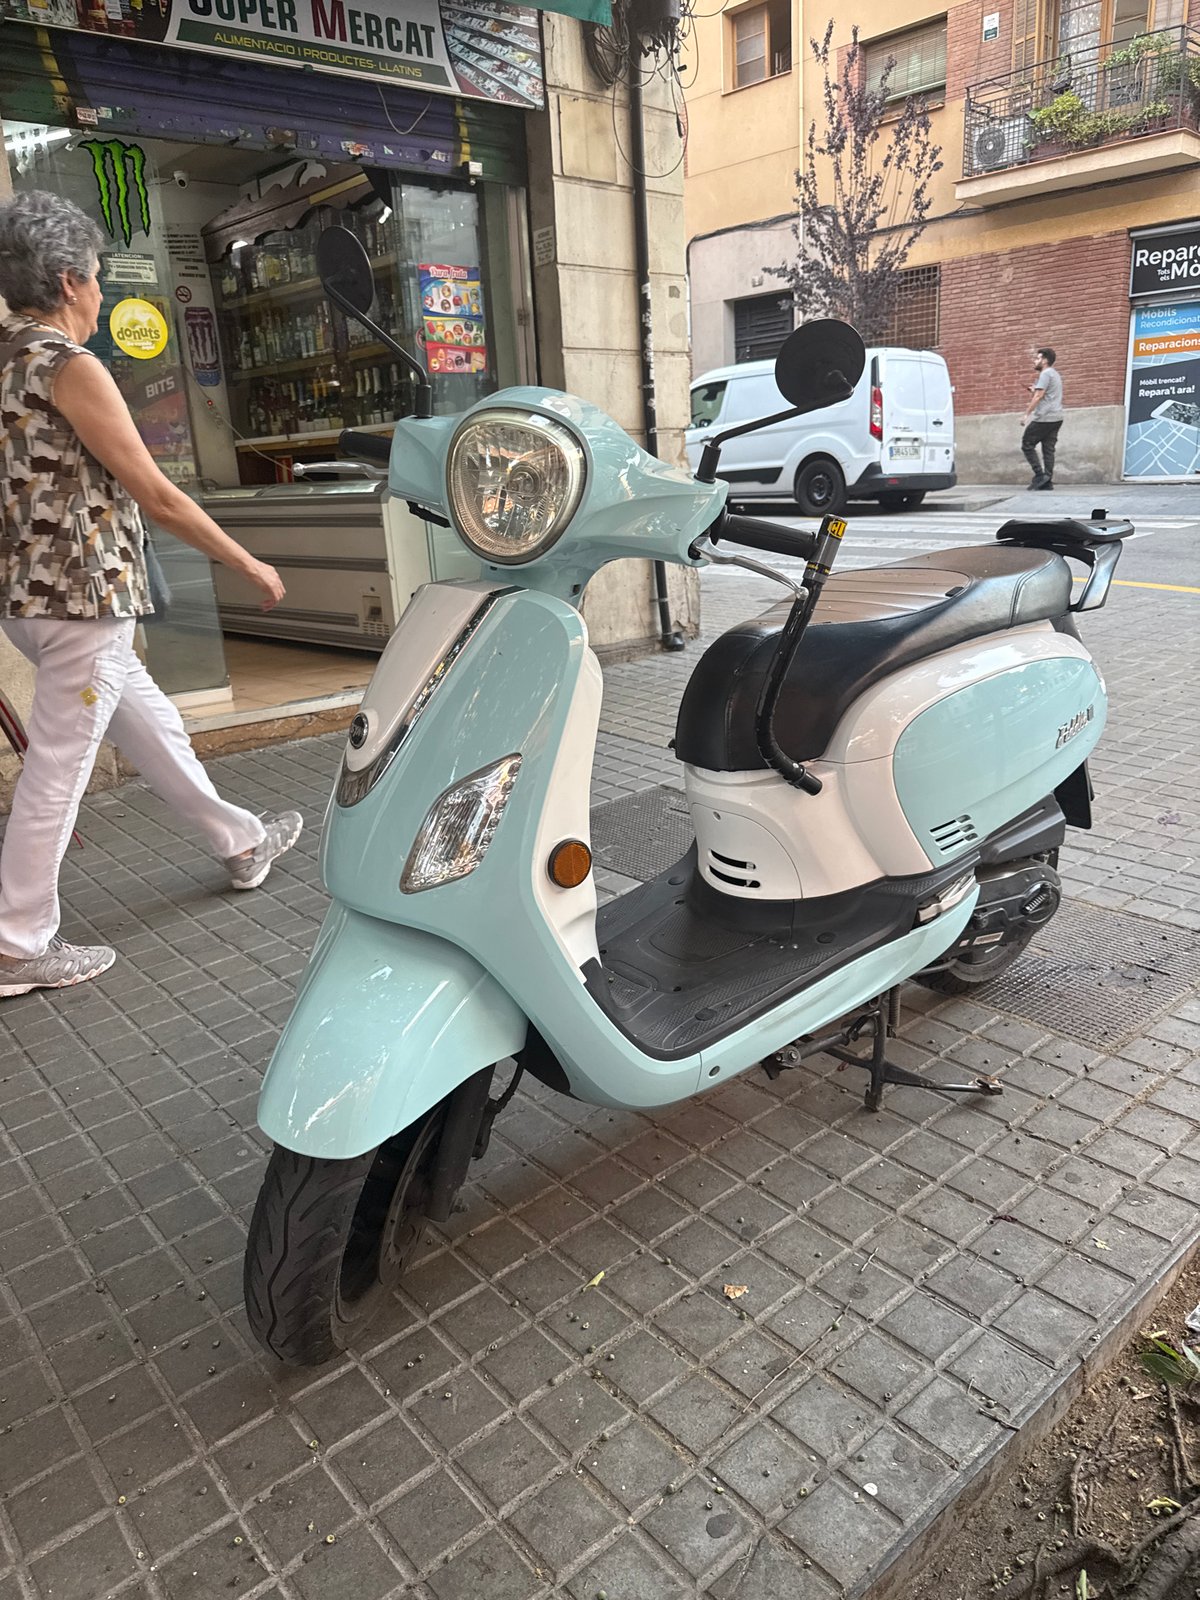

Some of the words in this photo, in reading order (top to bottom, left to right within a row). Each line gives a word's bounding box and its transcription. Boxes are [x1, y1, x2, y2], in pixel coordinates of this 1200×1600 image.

[310, 0, 435, 59] MERCAT
[214, 32, 295, 55] ALIMENTACIO
[379, 61, 422, 77] LLATINS
[1136, 245, 1200, 268] Repar
[116, 327, 160, 341] donuts
[145, 376, 175, 399] BITS
[1138, 386, 1175, 398] Repara'l
[1177, 384, 1196, 394] ara!
[1158, 376, 1186, 385] trencat?
